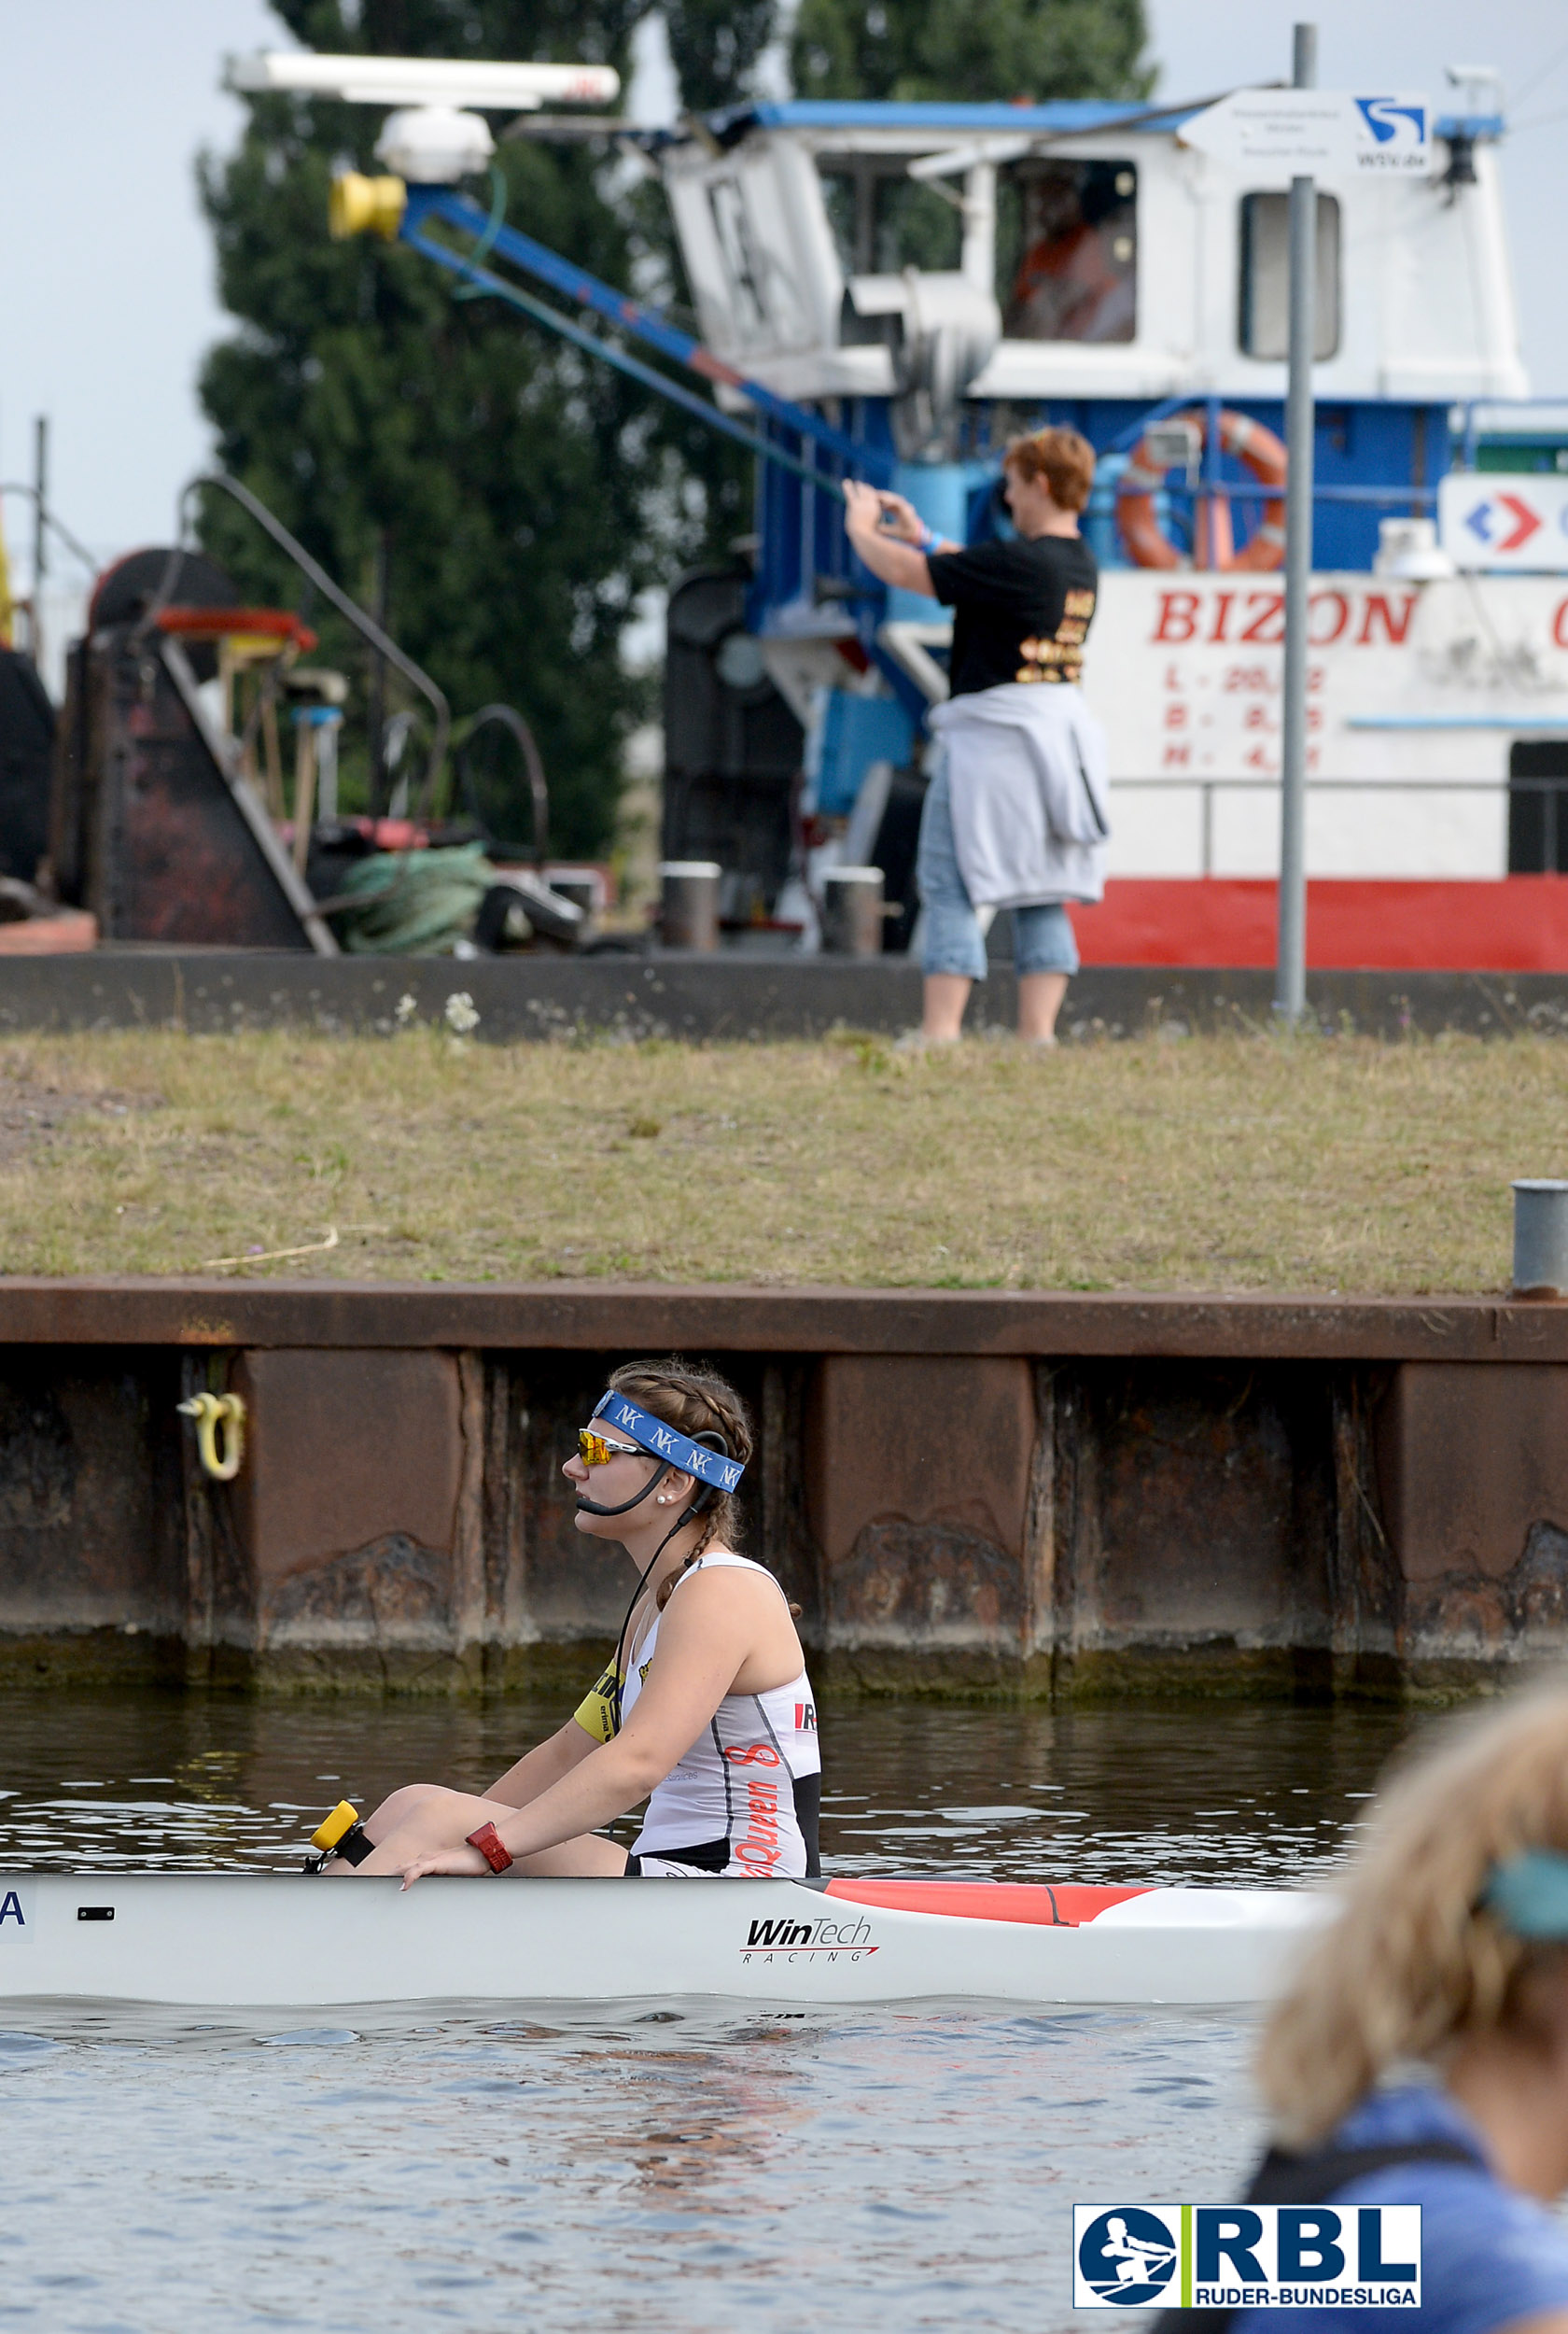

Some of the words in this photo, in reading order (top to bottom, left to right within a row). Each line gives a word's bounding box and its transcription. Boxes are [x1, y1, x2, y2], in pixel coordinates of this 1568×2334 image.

[1150, 590, 1421, 647] BIZON
[614, 1403, 645, 1430] NK
[649, 1427, 679, 1455] NK
[685, 1449, 713, 1474] NK
[720, 1465, 741, 1486] NK
[600, 1705, 609, 1732] erima
[724, 1744, 780, 1767] 8
[747, 1916, 872, 1946] WinTech
[743, 1951, 861, 1963] RACING
